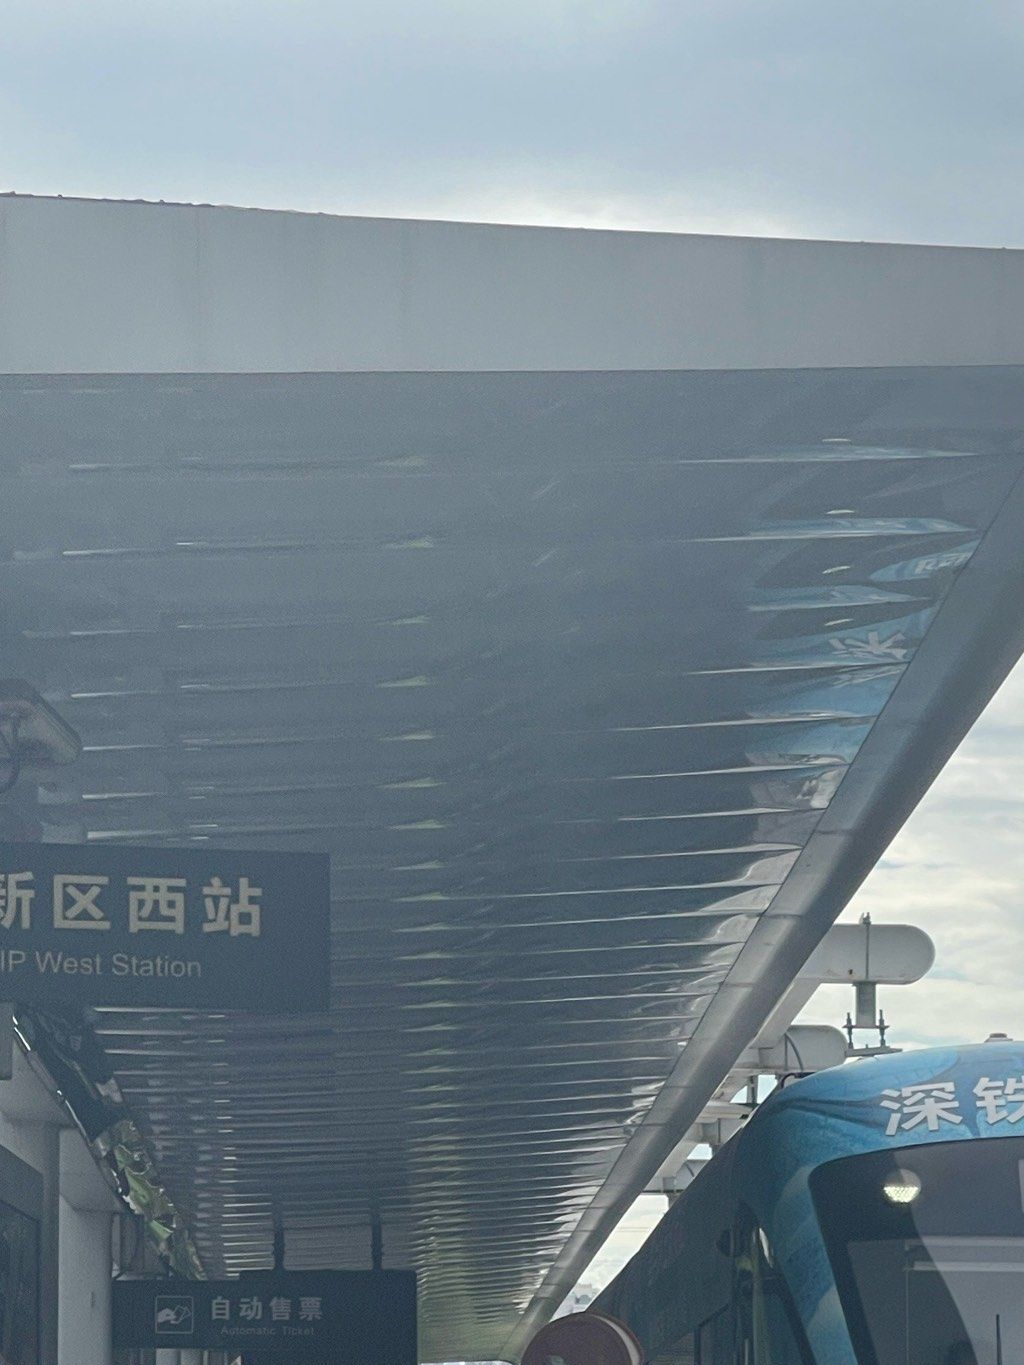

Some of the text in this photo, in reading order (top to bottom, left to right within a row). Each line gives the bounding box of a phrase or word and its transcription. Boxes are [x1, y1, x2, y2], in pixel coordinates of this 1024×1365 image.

[0, 871, 263, 938] 新区西站
[35, 950, 102, 975] West
[112, 952, 201, 978] Station
[211, 1295, 323, 1322] 自动售票
[220, 1325, 315, 1337] Automatic Ticket
